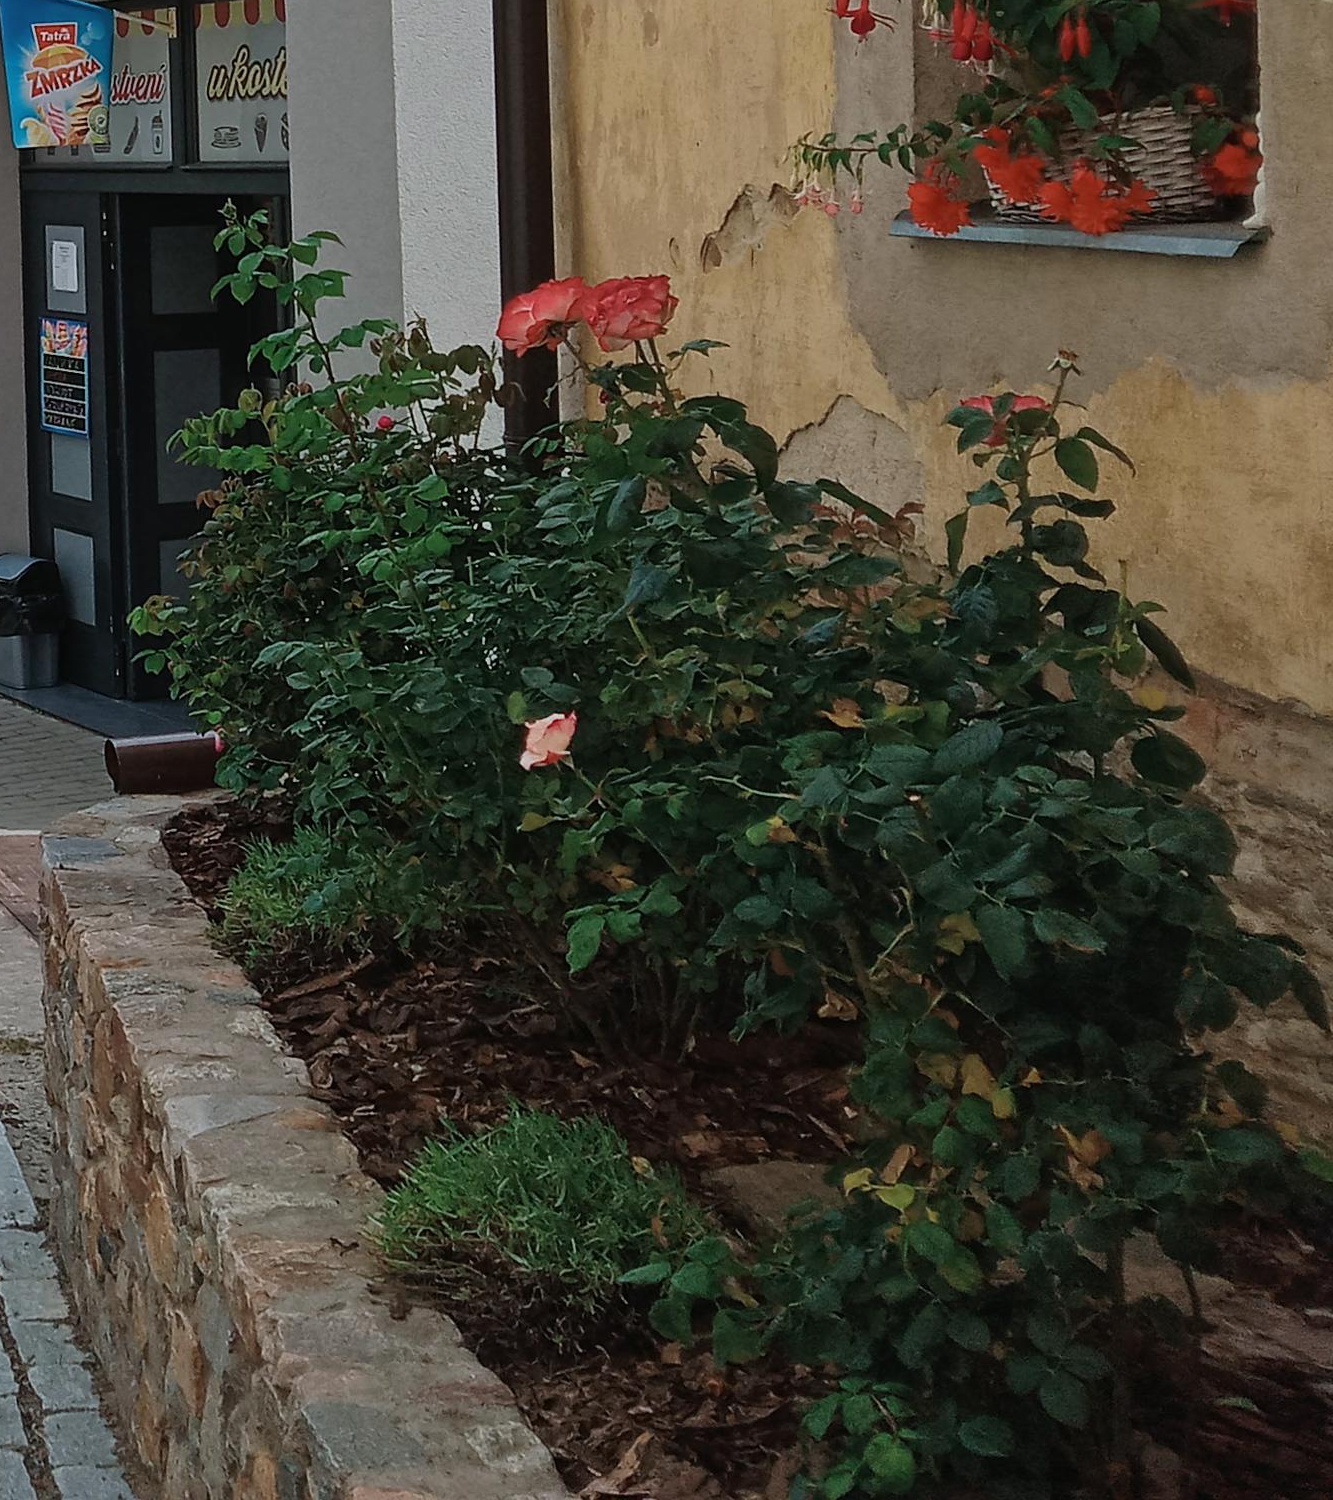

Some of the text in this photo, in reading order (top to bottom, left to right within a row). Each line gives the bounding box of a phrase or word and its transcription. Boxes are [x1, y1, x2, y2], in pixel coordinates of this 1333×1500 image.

[40, 31, 71, 42] Tatra
[25, 57, 102, 98] ZMRZKA
[111, 64, 166, 102] stvení
